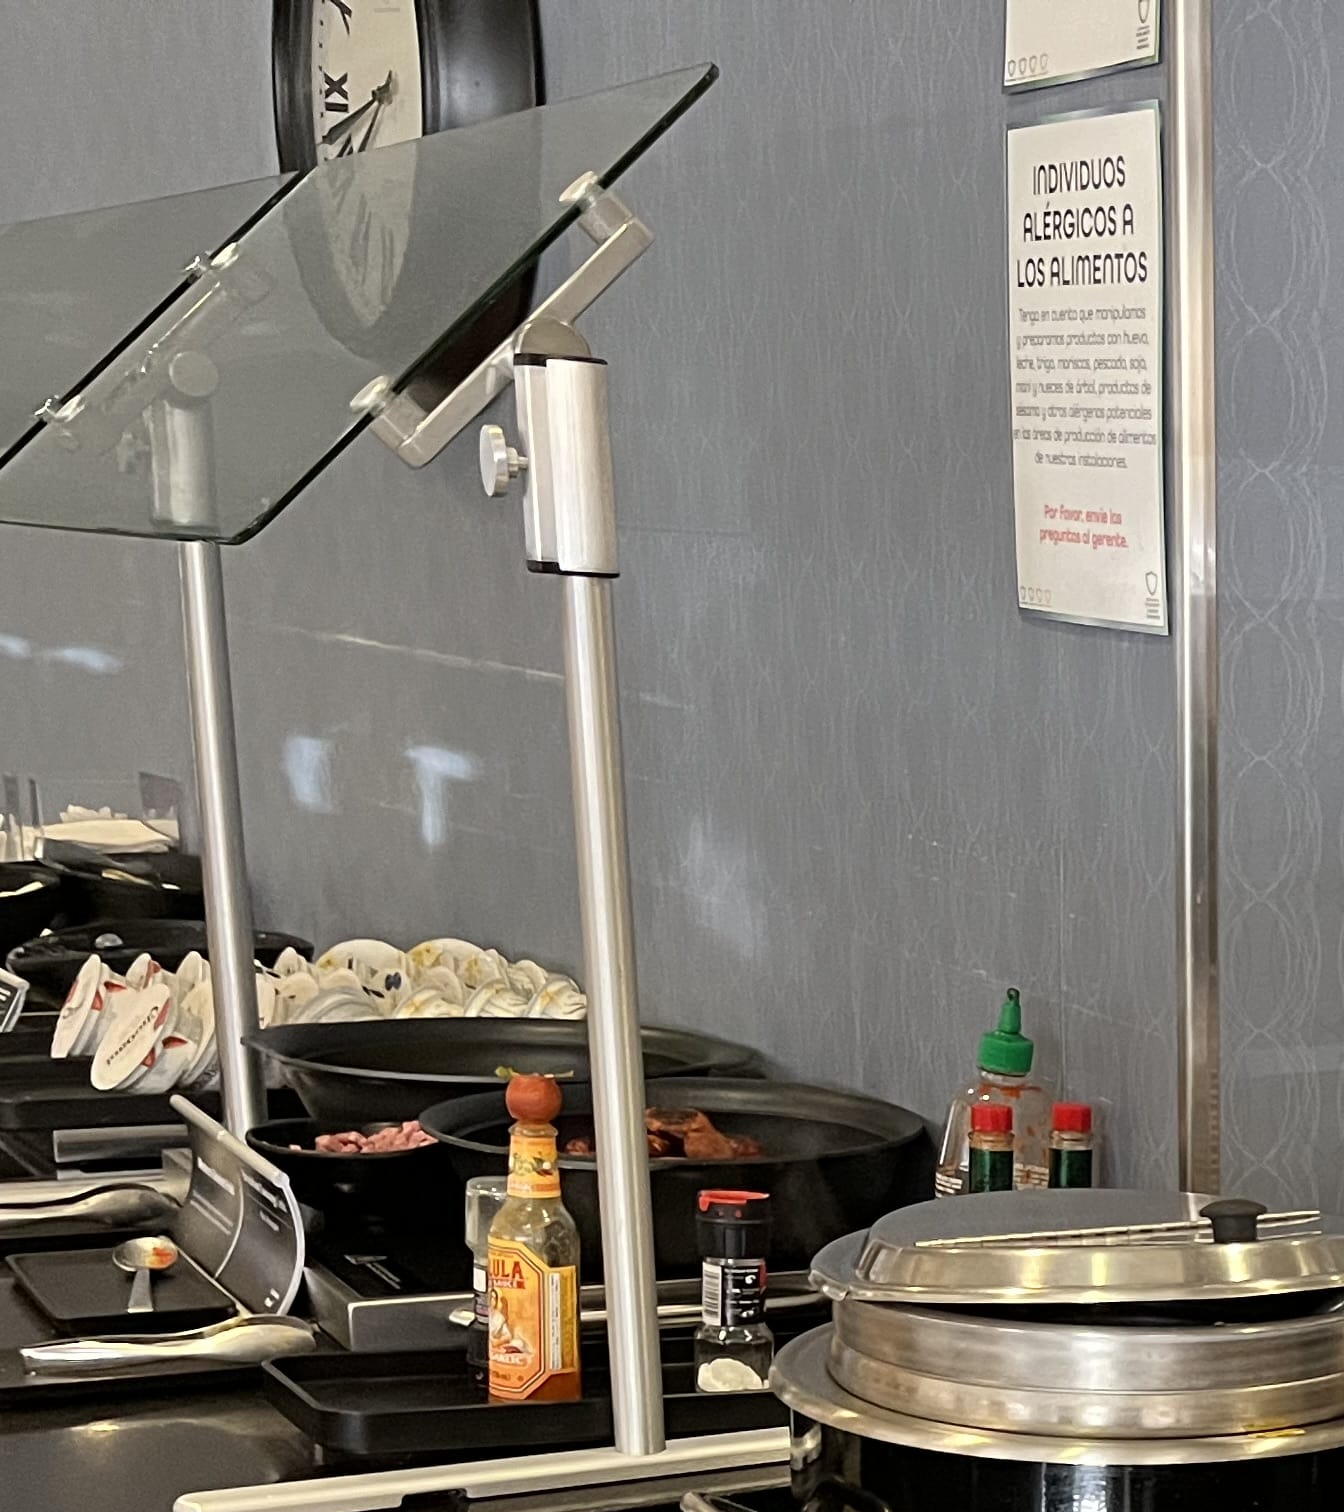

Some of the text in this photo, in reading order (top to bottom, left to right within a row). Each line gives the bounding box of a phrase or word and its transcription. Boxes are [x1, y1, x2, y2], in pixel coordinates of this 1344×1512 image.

[1033, 155, 1126, 195] INDIVIDUOS
[1023, 201, 1134, 243] ALÉRGICOS A
[1017, 251, 1148, 288] LOS ALIMENTOS
[1044, 504, 1058, 519] Por
[489, 1259, 524, 1279] ULA
